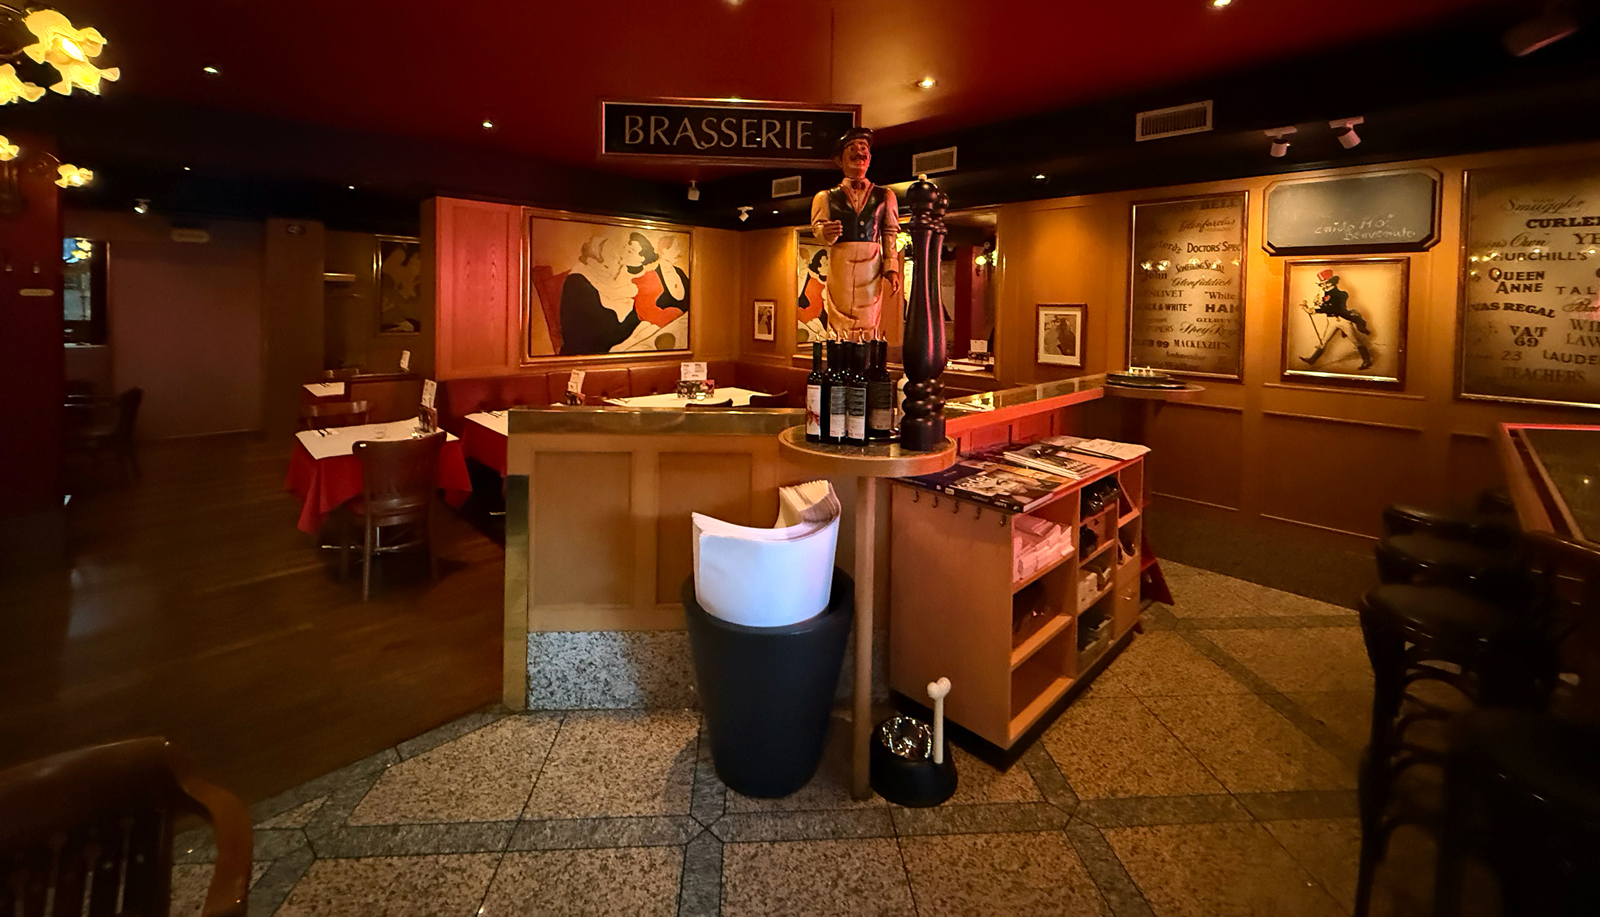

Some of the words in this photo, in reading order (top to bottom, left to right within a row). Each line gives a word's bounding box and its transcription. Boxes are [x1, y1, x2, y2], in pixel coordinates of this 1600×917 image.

[624, 113, 814, 150] BRASSERIE
[1488, 266, 1545, 282] QUEEN
[1170, 277, 1232, 290] Glenfiddich
[1495, 281, 1543, 294] ANNE
[1503, 302, 1556, 319] REGAL
[1510, 325, 1548, 338] VAT
[1514, 336, 1539, 347] 69
[1500, 350, 1522, 361] 23
